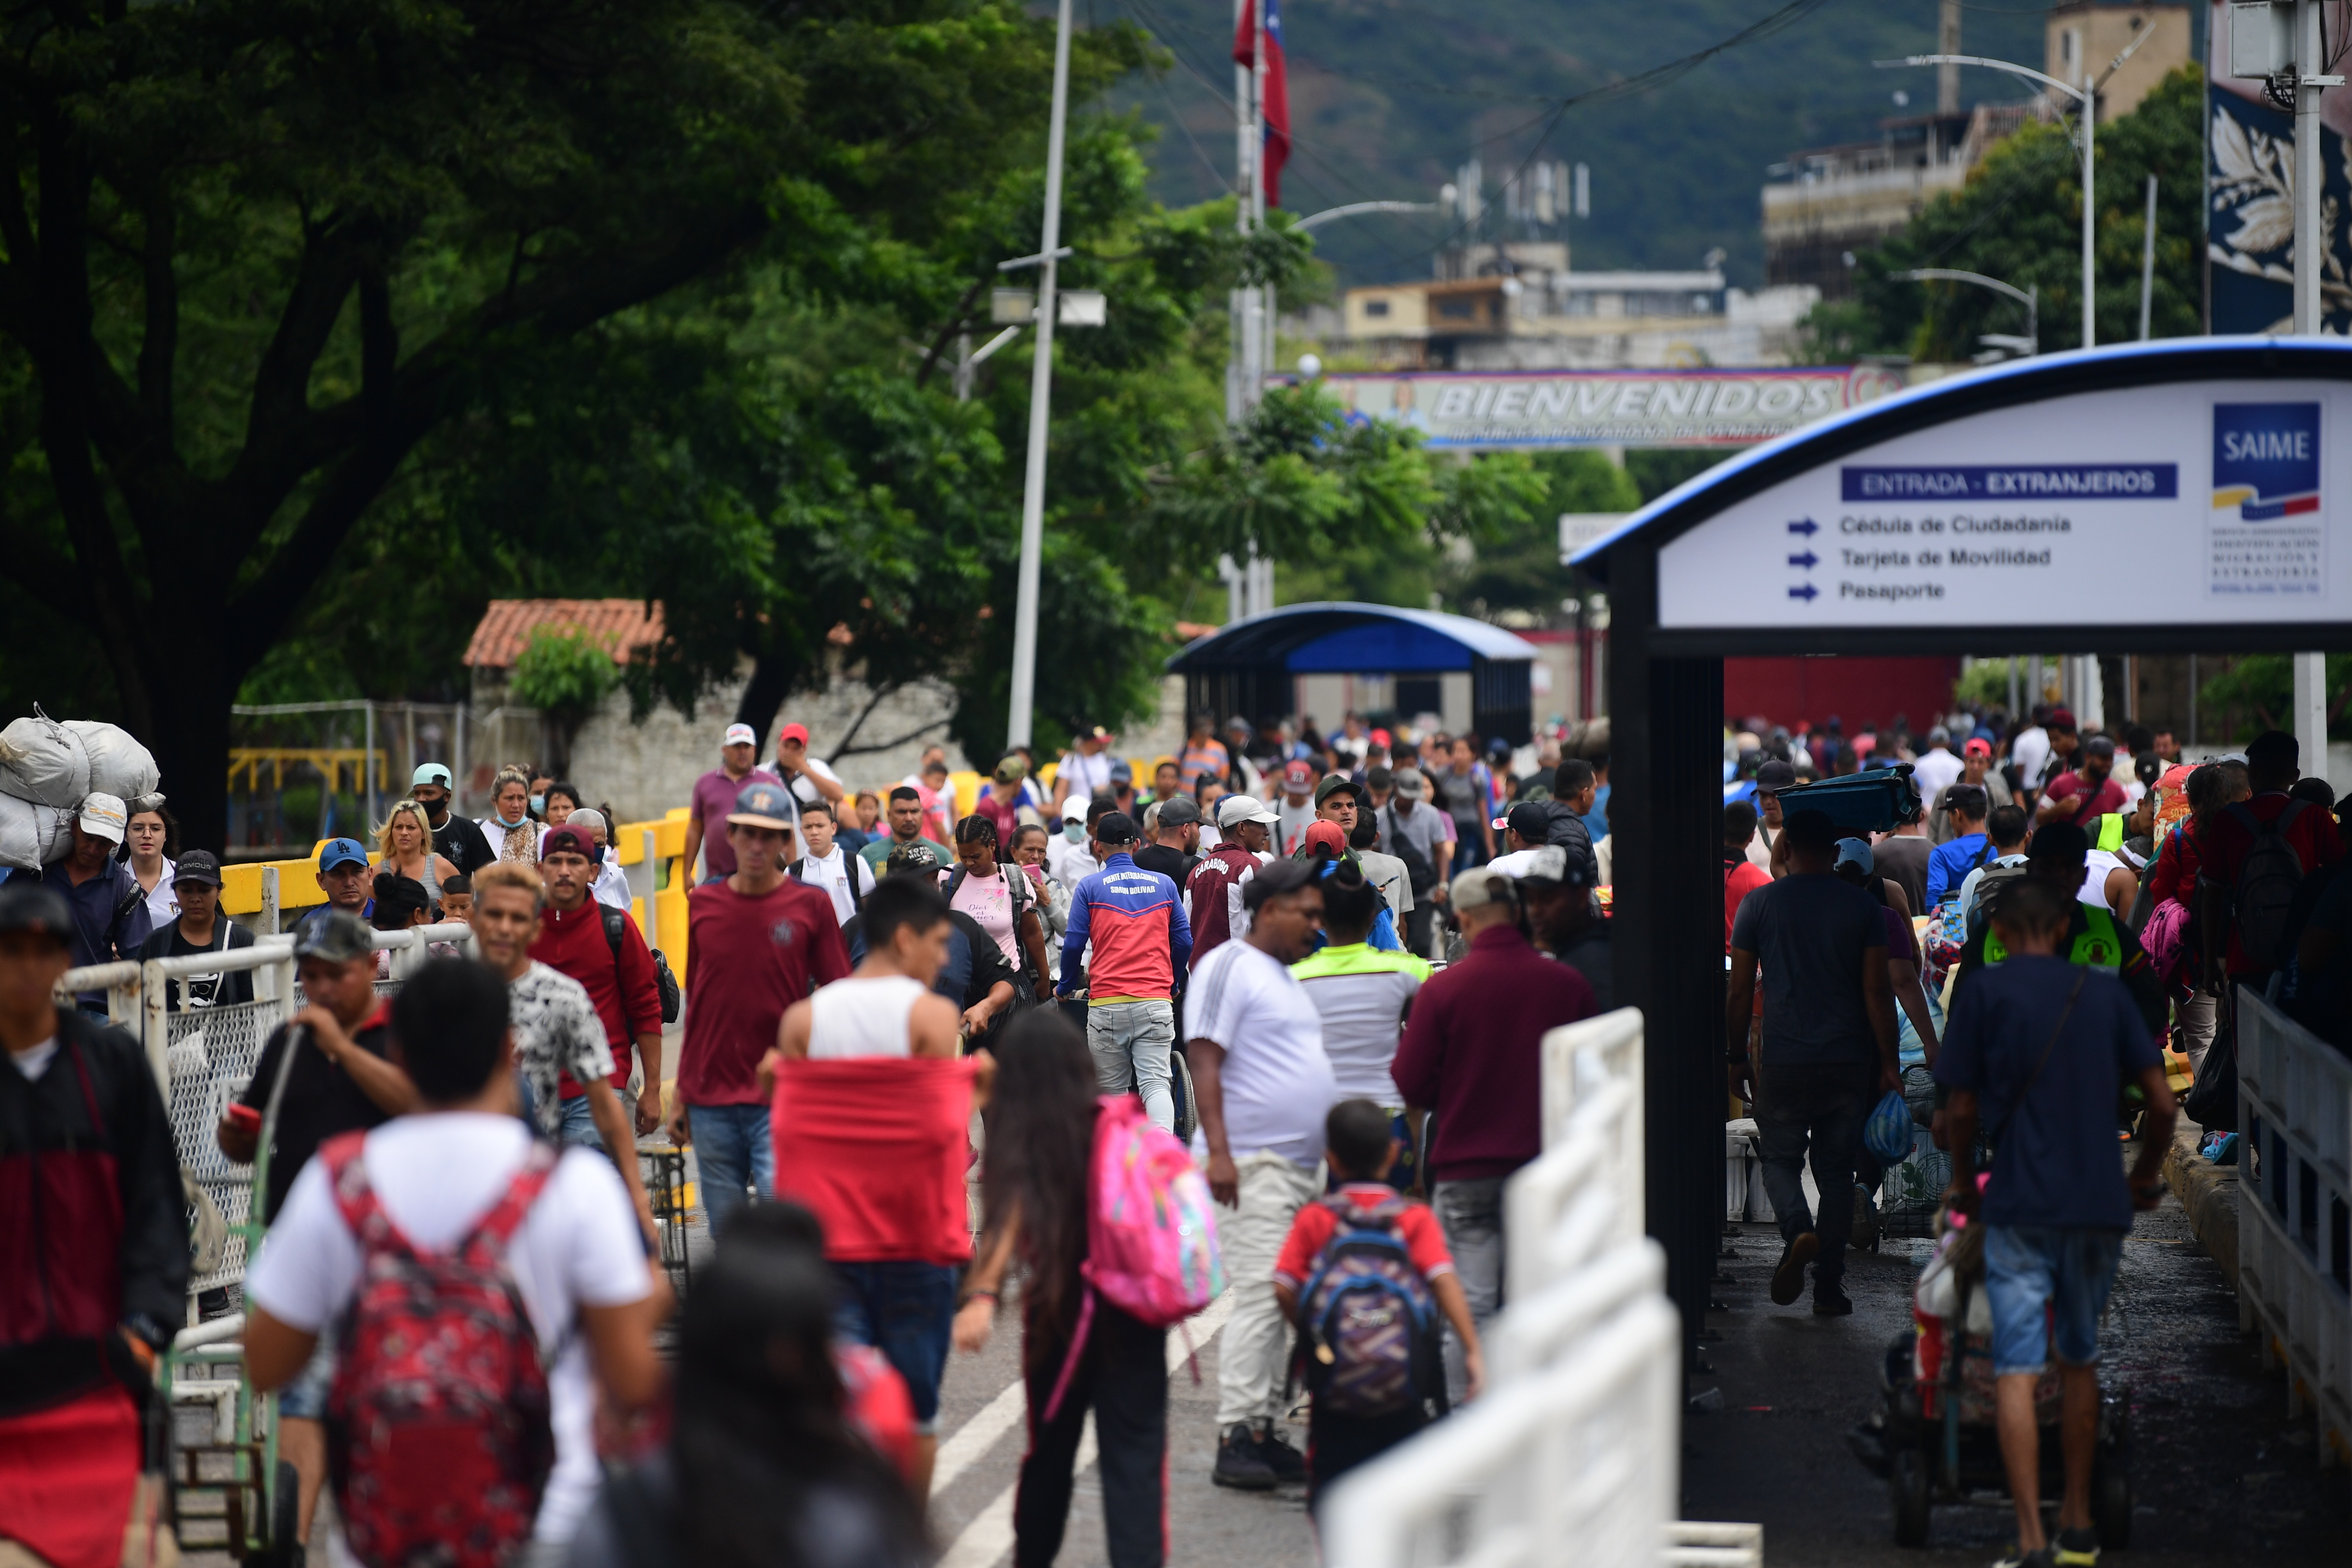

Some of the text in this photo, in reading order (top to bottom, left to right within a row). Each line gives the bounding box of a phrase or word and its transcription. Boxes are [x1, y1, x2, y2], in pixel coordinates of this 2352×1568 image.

[1436, 380, 1837, 417] BIENVENIDOS
[2223, 430, 2310, 460] SAIME
[1862, 472, 1969, 496] ENTRADA
[1987, 470, 2155, 494] EXTRANJEROS
[1841, 512, 2071, 534] Cédula de Ciudadanía
[1843, 549, 2051, 571] Tarjeta de Movilidad
[1840, 580, 1944, 602] Pasaporte
[336, 841, 350, 854] LA
[179, 863, 211, 871] ARMOUR
[1102, 871, 1160, 885] PUENTE INTERNACIONAL
[1195, 858, 1229, 879] CARABOBO
[1110, 886, 1156, 895] SIMON BOLIVAR
